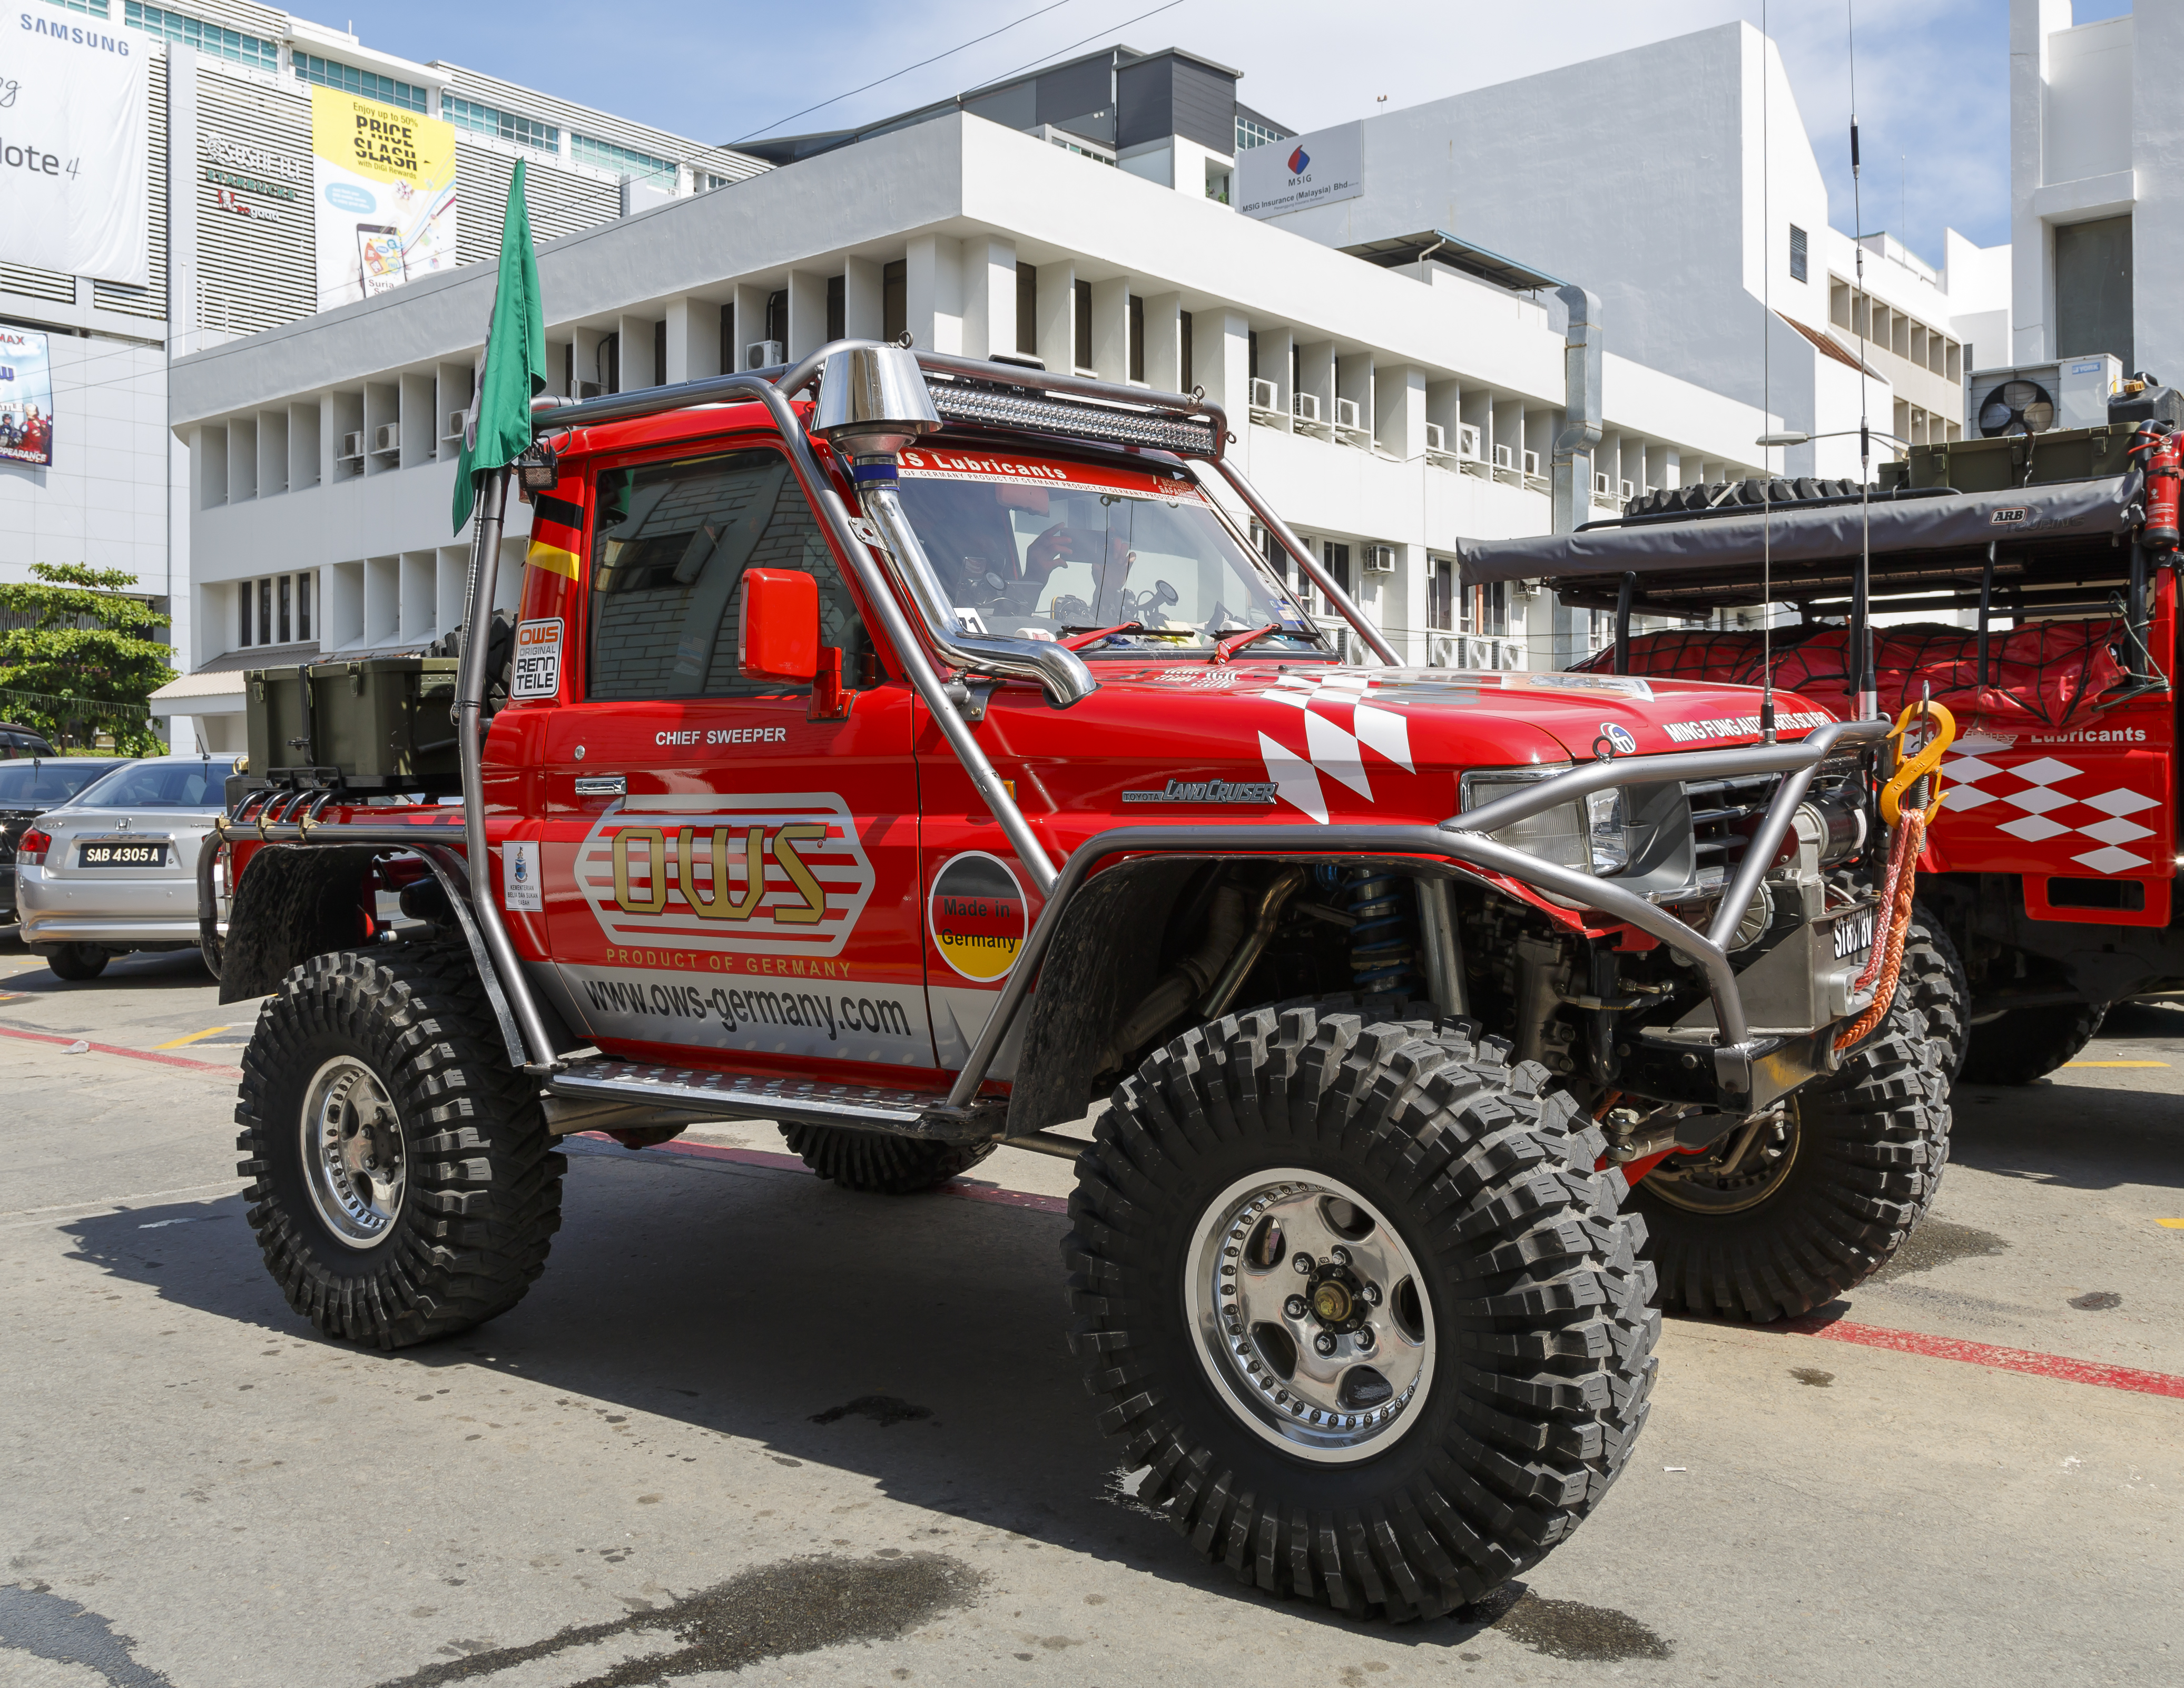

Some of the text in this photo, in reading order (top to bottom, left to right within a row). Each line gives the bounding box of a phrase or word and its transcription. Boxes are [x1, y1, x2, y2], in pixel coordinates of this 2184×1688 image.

[21, 14, 129, 56] SAMSUNG
[353, 102, 418, 127] Enjoy up to 50%
[356, 114, 414, 148] PRICE
[0, 137, 81, 181] ote 4
[224, 143, 300, 180] SUSHI TEI
[354, 138, 417, 172] SLASH
[206, 169, 296, 200] STARBUCKS
[389, 165, 417, 180] Rewards
[1288, 174, 1312, 187] MSIG
[1242, 202, 1260, 213] MSIG
[1262, 194, 1294, 208] Insurance
[1296, 185, 1331, 201] (Malaysia)
[1334, 181, 1348, 191] Bhd
[369, 279, 394, 289] Suria
[931, 454, 1067, 479] Lubricants
[920, 470, 965, 479] GERMANY
[967, 474, 1008, 482] PRODUCT
[1021, 477, 1060, 487] GERMANY
[1061, 482, 1098, 491] PRODUCT
[1109, 487, 1143, 497] GERMANY
[1145, 492, 1176, 502] PRODUCT
[1160, 478, 1192, 491] BORNEO
[1994, 510, 2023, 522] ARB
[2005, 515, 2085, 533] TOURING
[519, 625, 559, 645] OWS
[519, 645, 556, 656] ORIGINAL
[516, 672, 554, 690] TEILE
[655, 728, 786, 745] CHIEF SWEEPER
[1663, 721, 1707, 743] MING
[1699, 718, 1742, 738] FUNG
[1774, 713, 1801, 731] ARTS
[1792, 712, 1818, 729] SDN
[1809, 711, 1832, 727] BHD
[1124, 792, 1160, 801] TOYOTA
[86, 848, 159, 862] SAB 4305 A
[612, 823, 827, 924] OWS
[943, 898, 1010, 918] Made in
[941, 928, 1016, 954] Germany
[606, 948, 850, 978] PRODUCT OF GERMANY
[582, 980, 912, 1041] www.ows-germany.com
